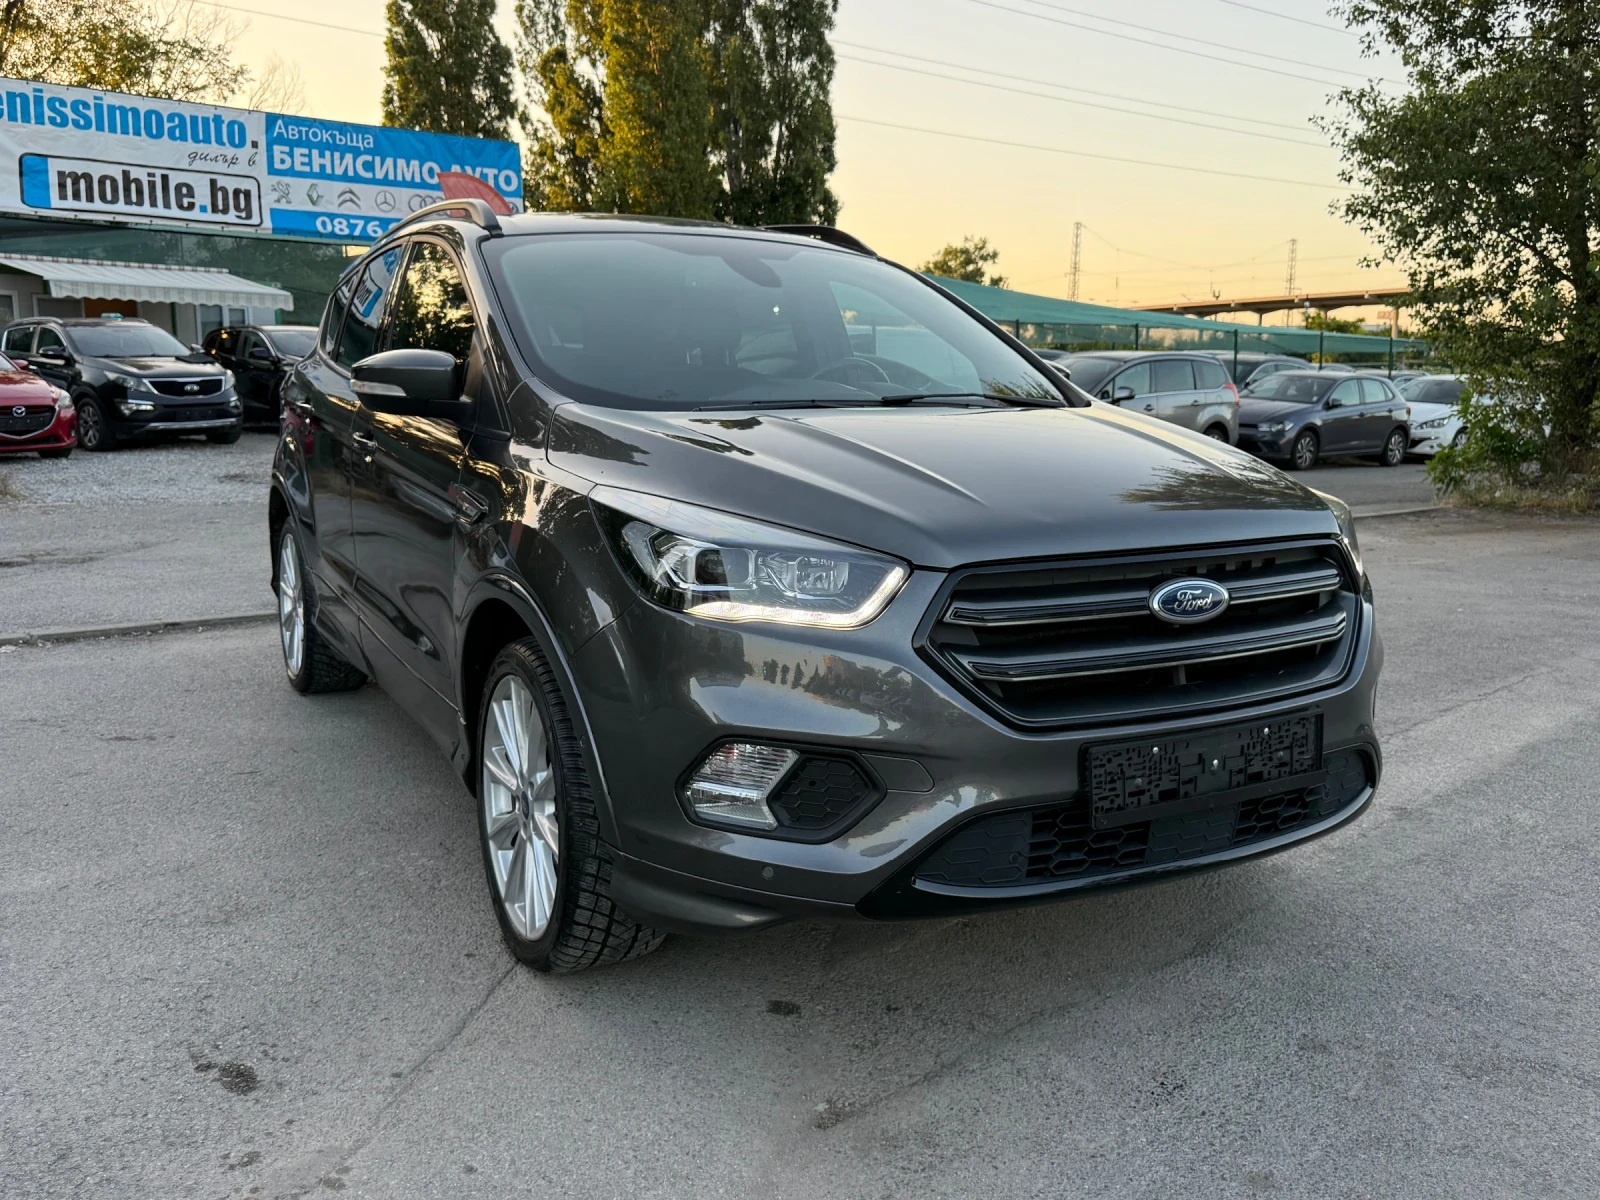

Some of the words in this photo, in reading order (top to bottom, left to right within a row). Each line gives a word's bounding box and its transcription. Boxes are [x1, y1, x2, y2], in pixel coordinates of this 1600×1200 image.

[0, 87, 259, 149] nissimoauto.
[273, 119, 374, 150] Автокъща
[272, 145, 440, 185] БЕНИСИМО
[57, 169, 253, 219] mobile.bg
[315, 216, 384, 238] 0876
[1173, 589, 1213, 612] Ford
